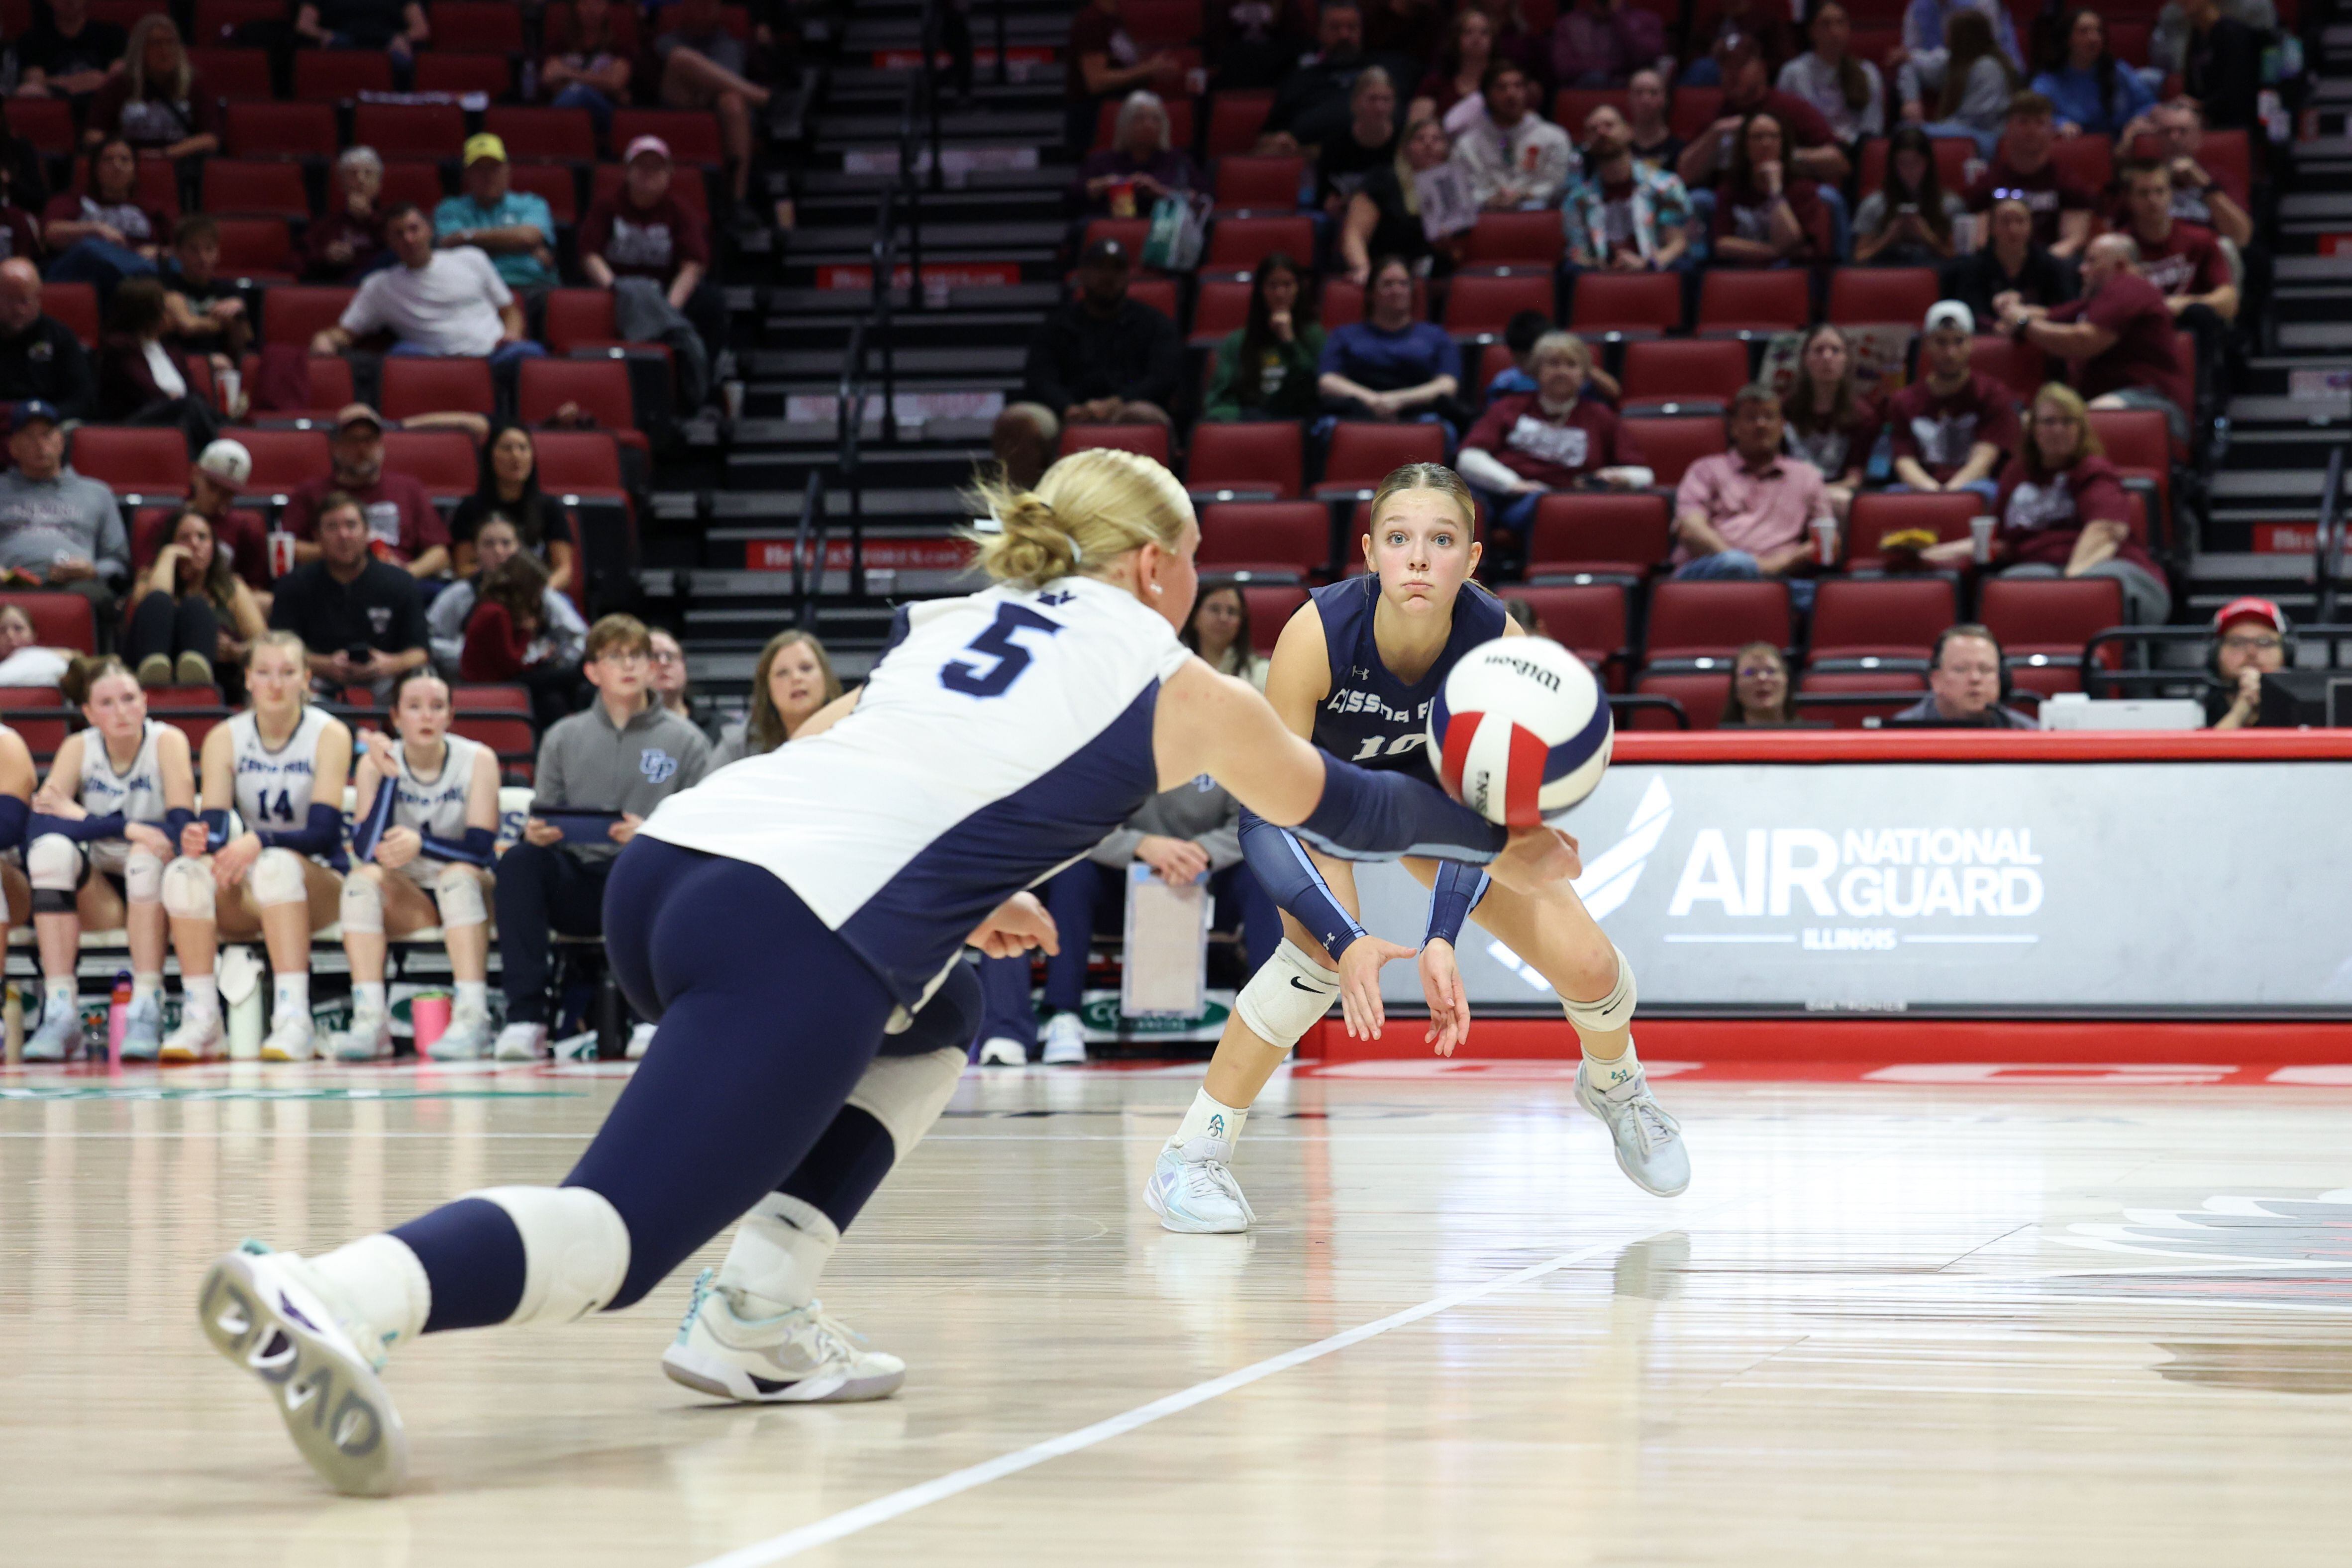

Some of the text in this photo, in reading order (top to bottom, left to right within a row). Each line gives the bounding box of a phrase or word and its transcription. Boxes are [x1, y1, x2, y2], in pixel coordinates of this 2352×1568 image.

[938, 601, 1066, 698] 5
[258, 788, 295, 821] 14
[1667, 828, 2043, 916] AIR NATIONAL
[1839, 866, 2044, 917] GUARD
[1802, 928, 1897, 950] ILLINOIS
